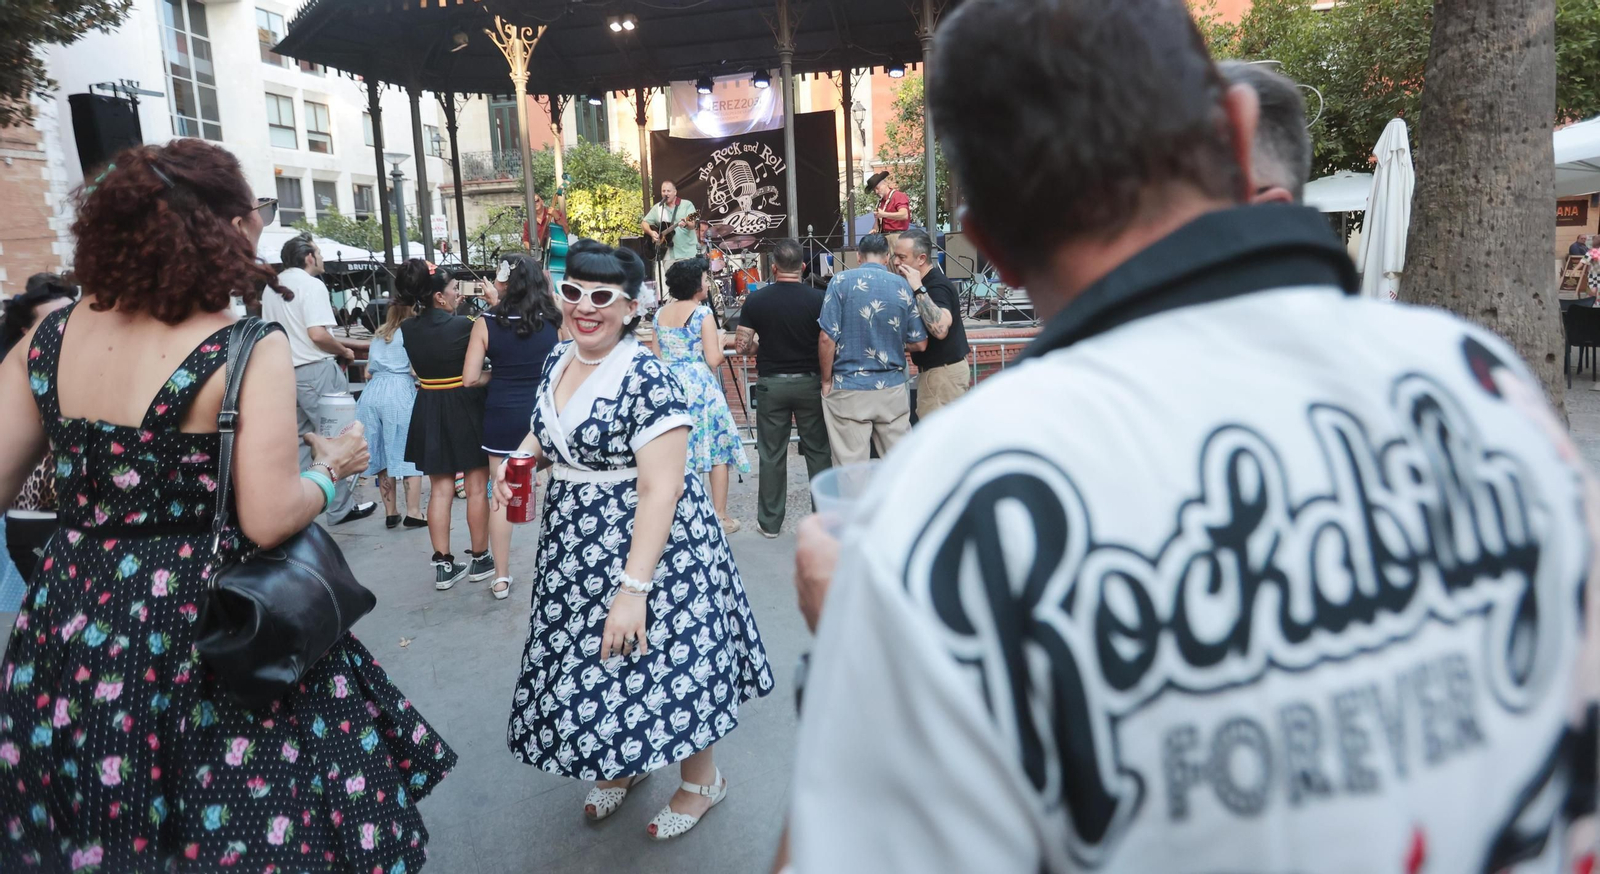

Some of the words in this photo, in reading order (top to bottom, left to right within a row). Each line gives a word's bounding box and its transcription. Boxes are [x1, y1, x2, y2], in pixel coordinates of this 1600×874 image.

[699, 161, 714, 182] The
[743, 141, 760, 154] and
[759, 143, 787, 176] Roll
[1556, 206, 1579, 216] ANA
